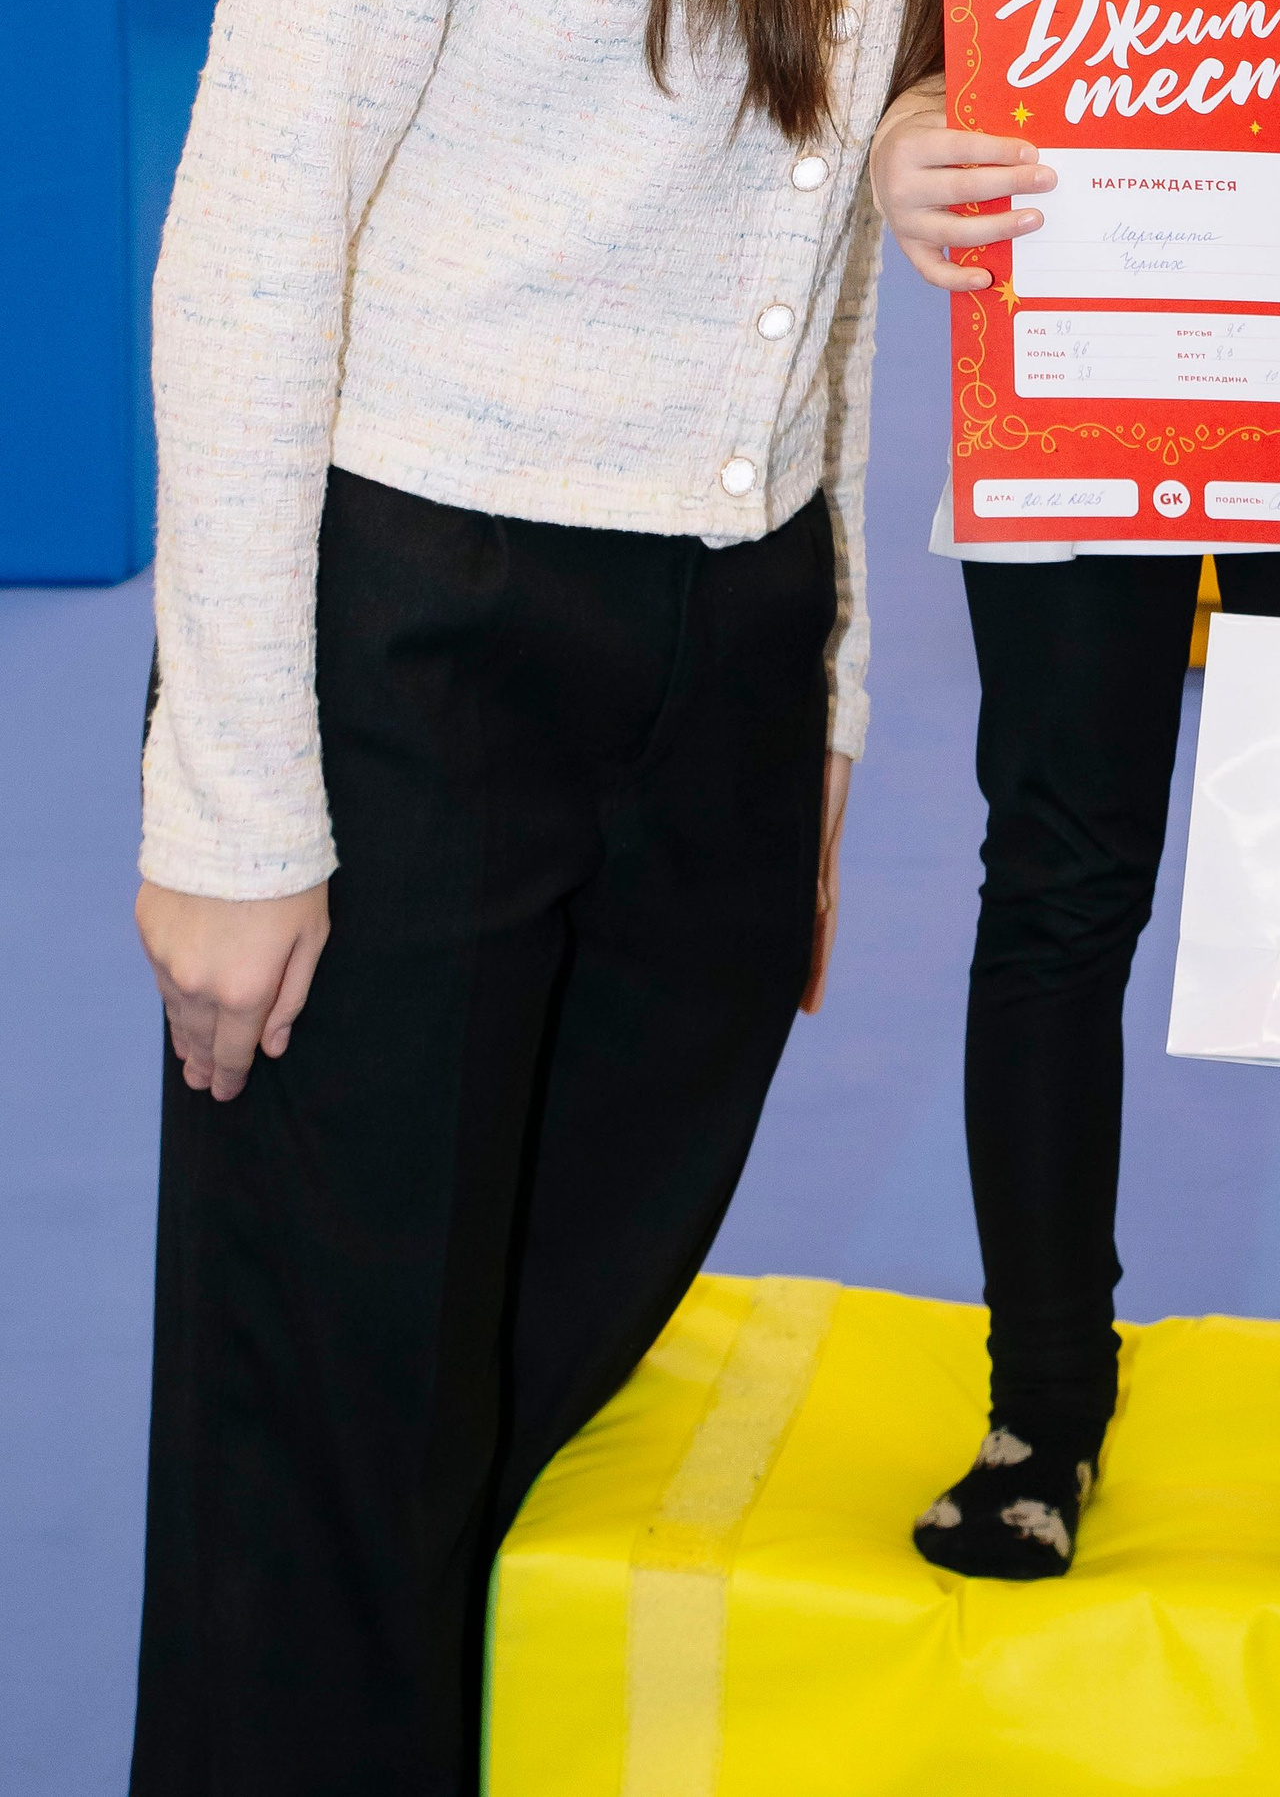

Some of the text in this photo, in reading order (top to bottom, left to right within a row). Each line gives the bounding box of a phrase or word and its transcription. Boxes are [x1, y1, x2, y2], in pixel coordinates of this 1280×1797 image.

[1091, 177, 1238, 193] НАГРАЖДАЕТСЯ
[1102, 222, 1223, 250] Маргарита
[1026, 351, 1067, 359] КОЛЬЦА
[1177, 352, 1207, 360] БАТУТ
[1027, 373, 1066, 381] БРЕВНО
[1177, 375, 1249, 384] ПЕРЕКЛАДИНА
[986, 494, 1015, 502] ДАТА:
[1160, 492, 1183, 505] GK
[1215, 496, 1264, 505] ПОДПИСЬ:
